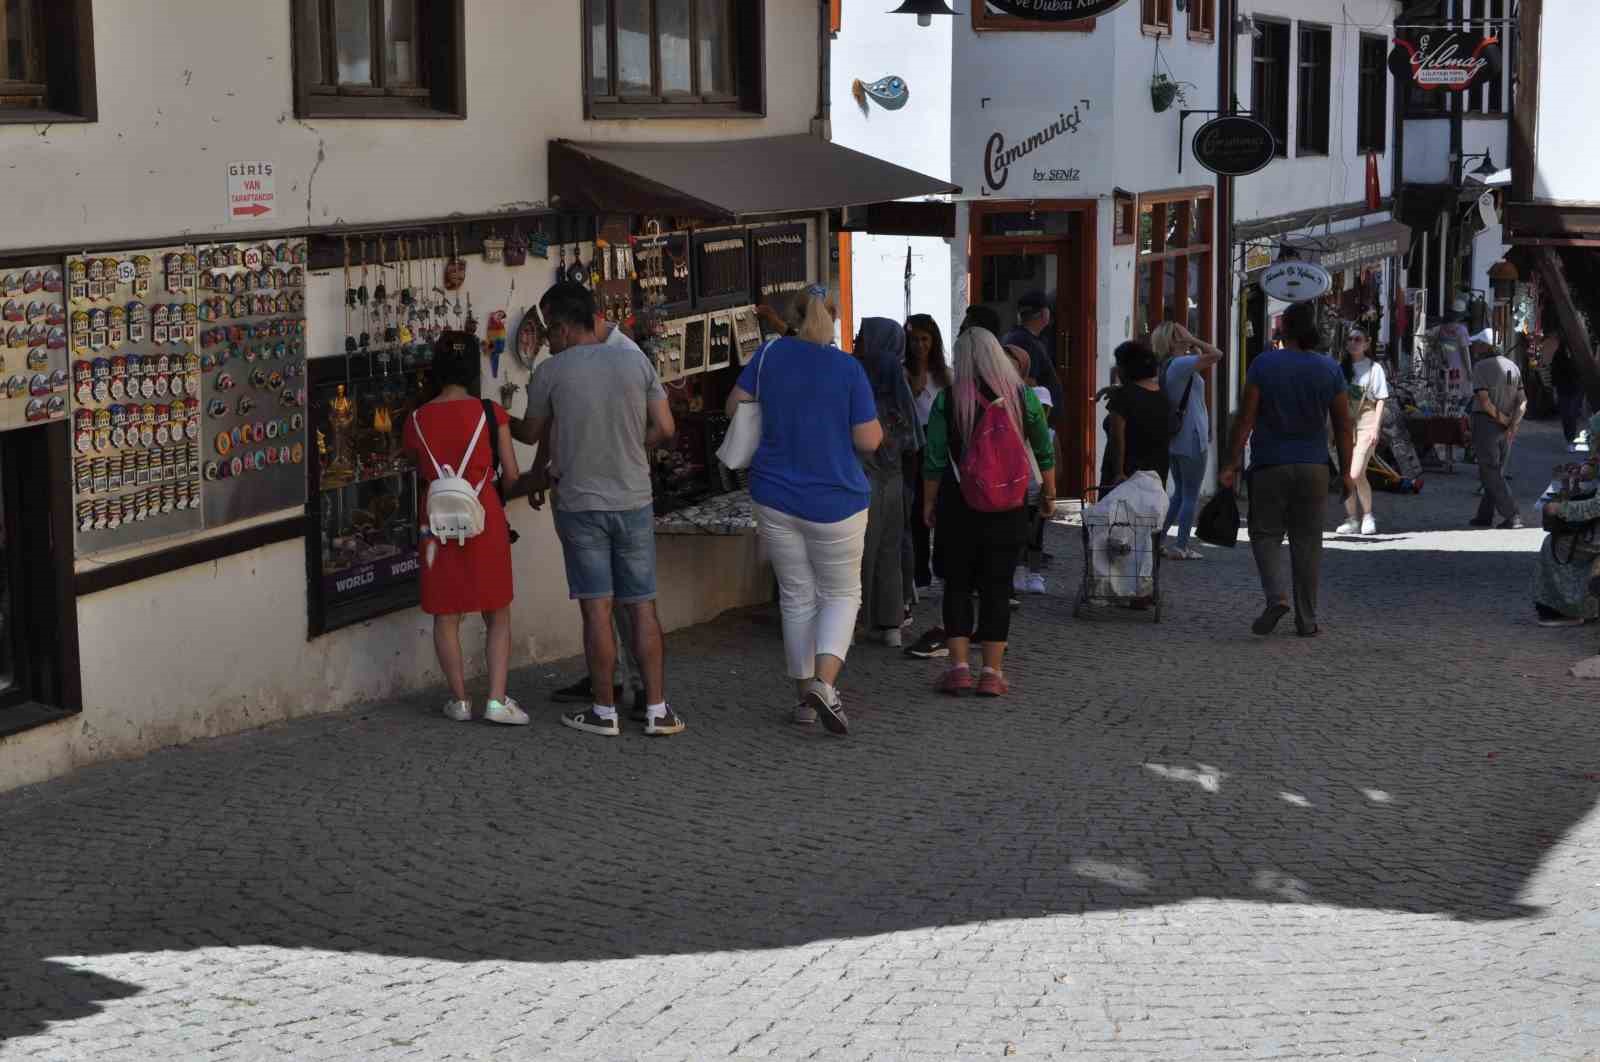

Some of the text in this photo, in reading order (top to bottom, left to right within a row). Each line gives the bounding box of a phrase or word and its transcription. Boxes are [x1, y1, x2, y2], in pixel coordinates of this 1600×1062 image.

[229, 163, 273, 176] GİRİŞ
[1032, 168, 1046, 181] by
[243, 179, 261, 190] YAN
[392, 560, 419, 575] WORL
[336, 572, 374, 592] WORLD
